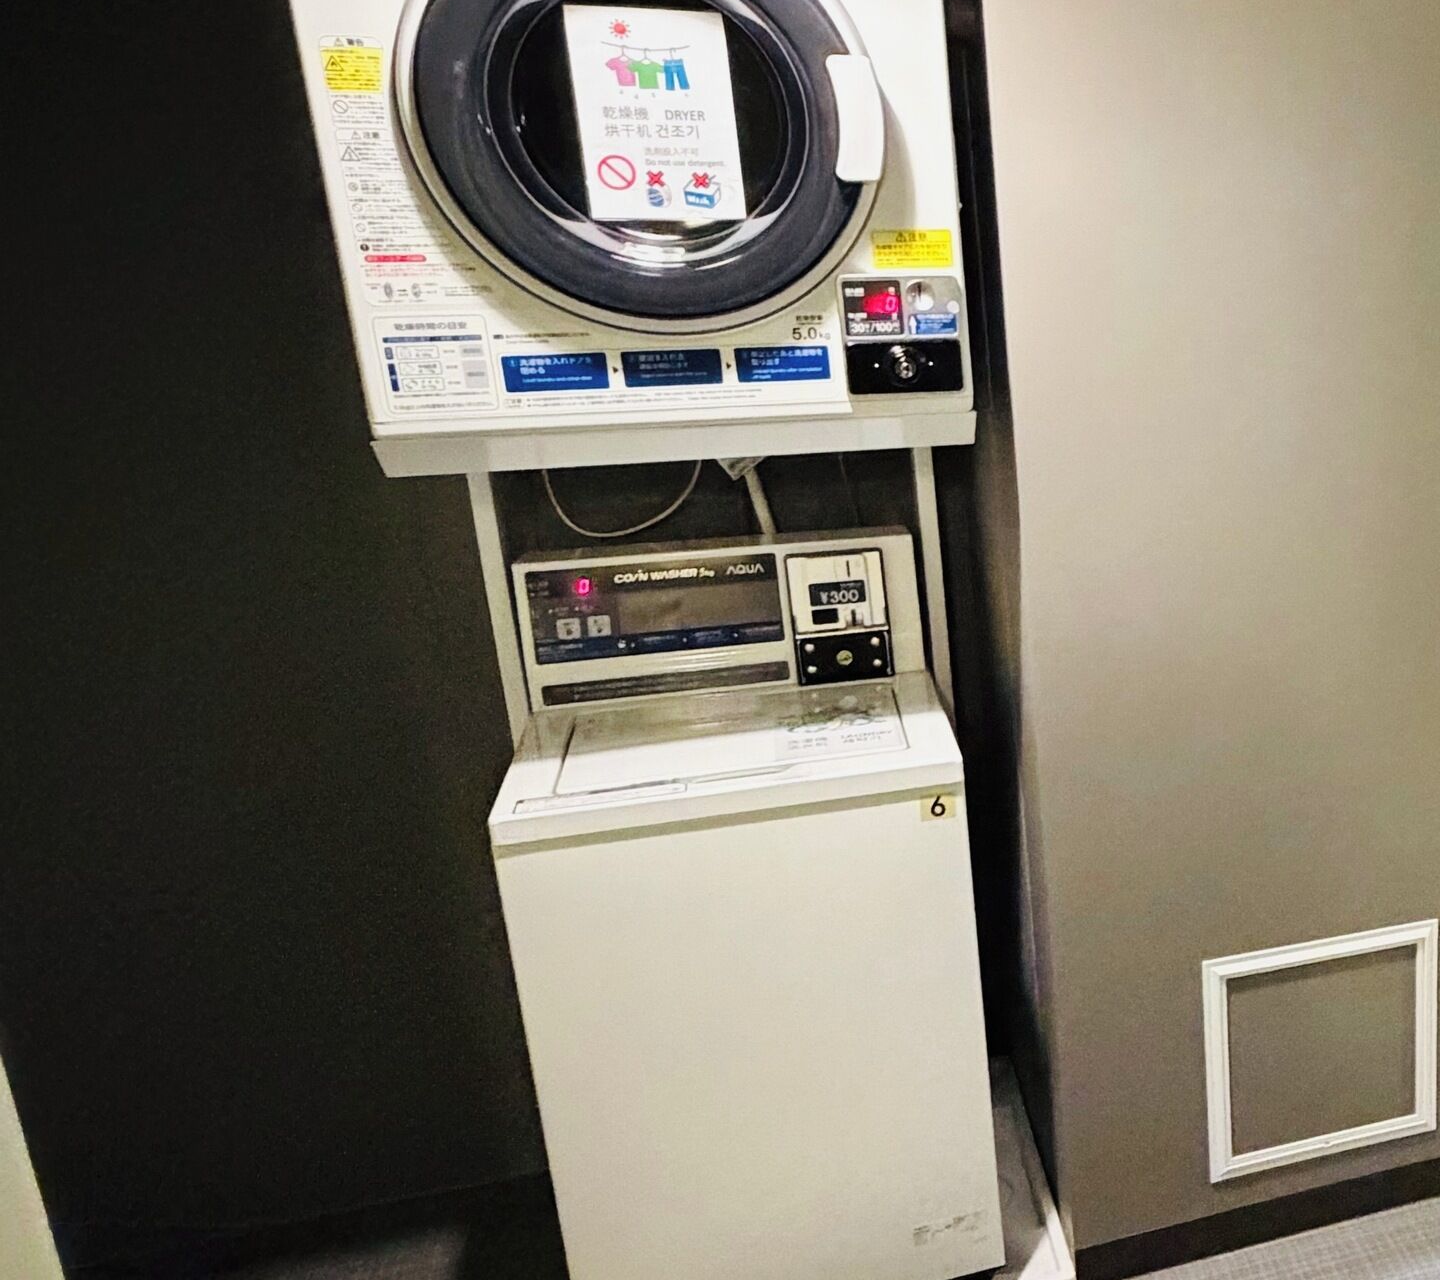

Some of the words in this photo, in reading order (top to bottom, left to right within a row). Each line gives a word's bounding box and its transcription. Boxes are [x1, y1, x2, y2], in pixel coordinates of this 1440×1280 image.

[603, 106, 649, 121] 乾燥機
[665, 109, 706, 121] DRYER
[604, 124, 652, 139] 烘干机
[656, 124, 700, 139] 건조기
[792, 327, 817, 340] 5.0
[614, 570, 649, 584] COIN
[650, 568, 698, 581] WASHER
[726, 563, 765, 575] AQUA
[579, 578, 590, 594] 0
[820, 589, 860, 604] ¥300
[930, 795, 946, 817] 6
